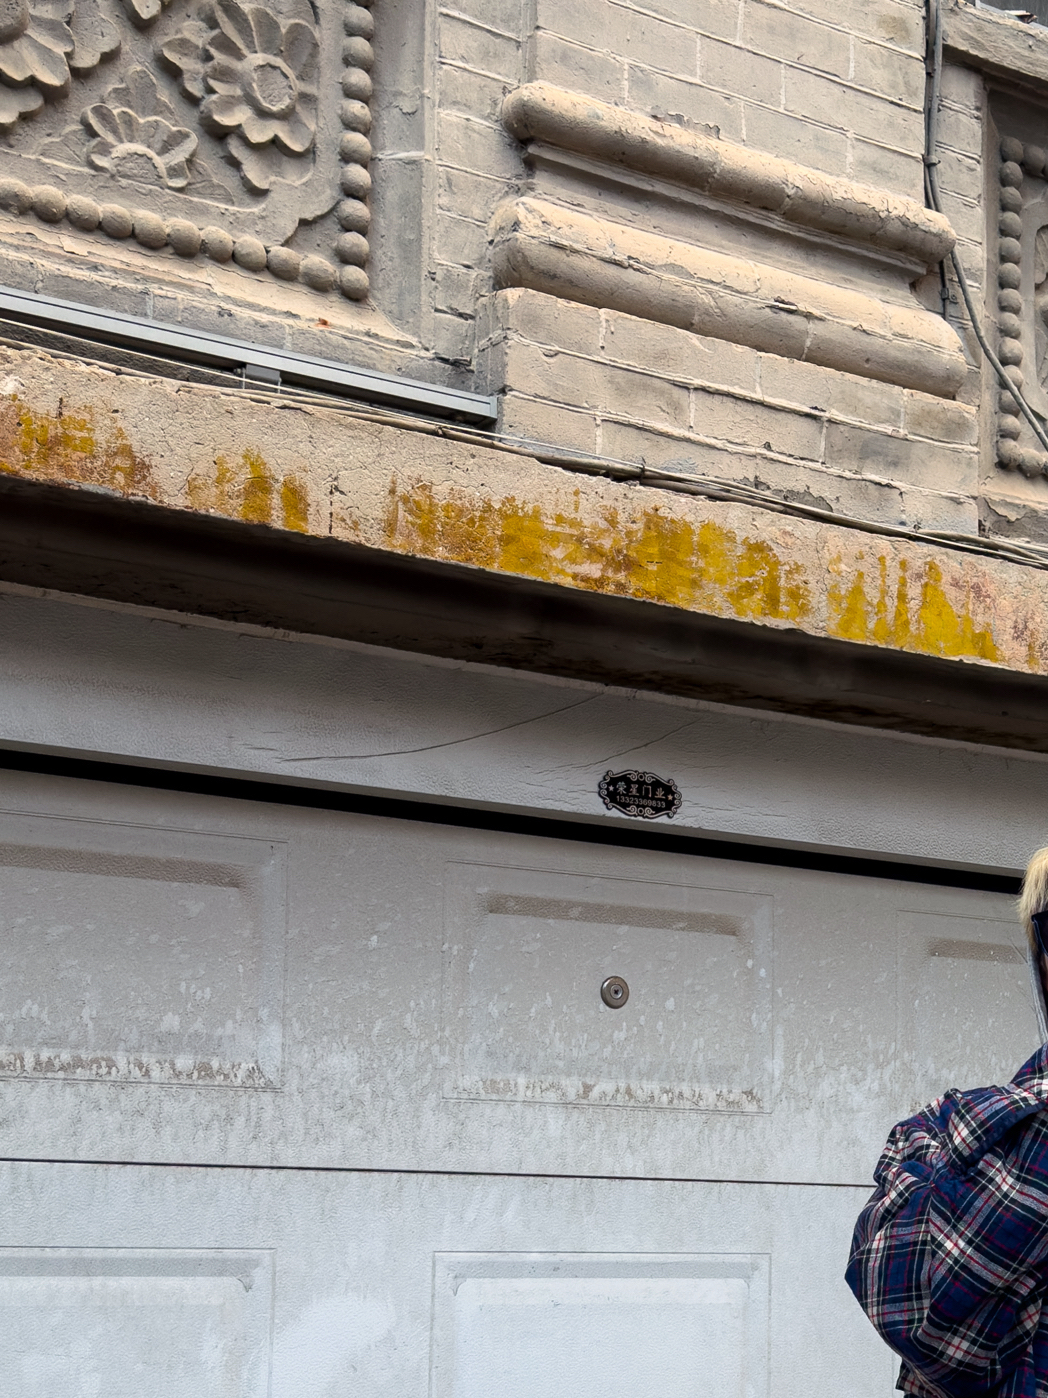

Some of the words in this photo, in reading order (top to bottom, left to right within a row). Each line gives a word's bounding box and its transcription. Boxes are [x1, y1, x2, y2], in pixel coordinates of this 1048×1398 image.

[616, 781, 666, 799] 荣星门业
[616, 795, 666, 808] 13323369833
